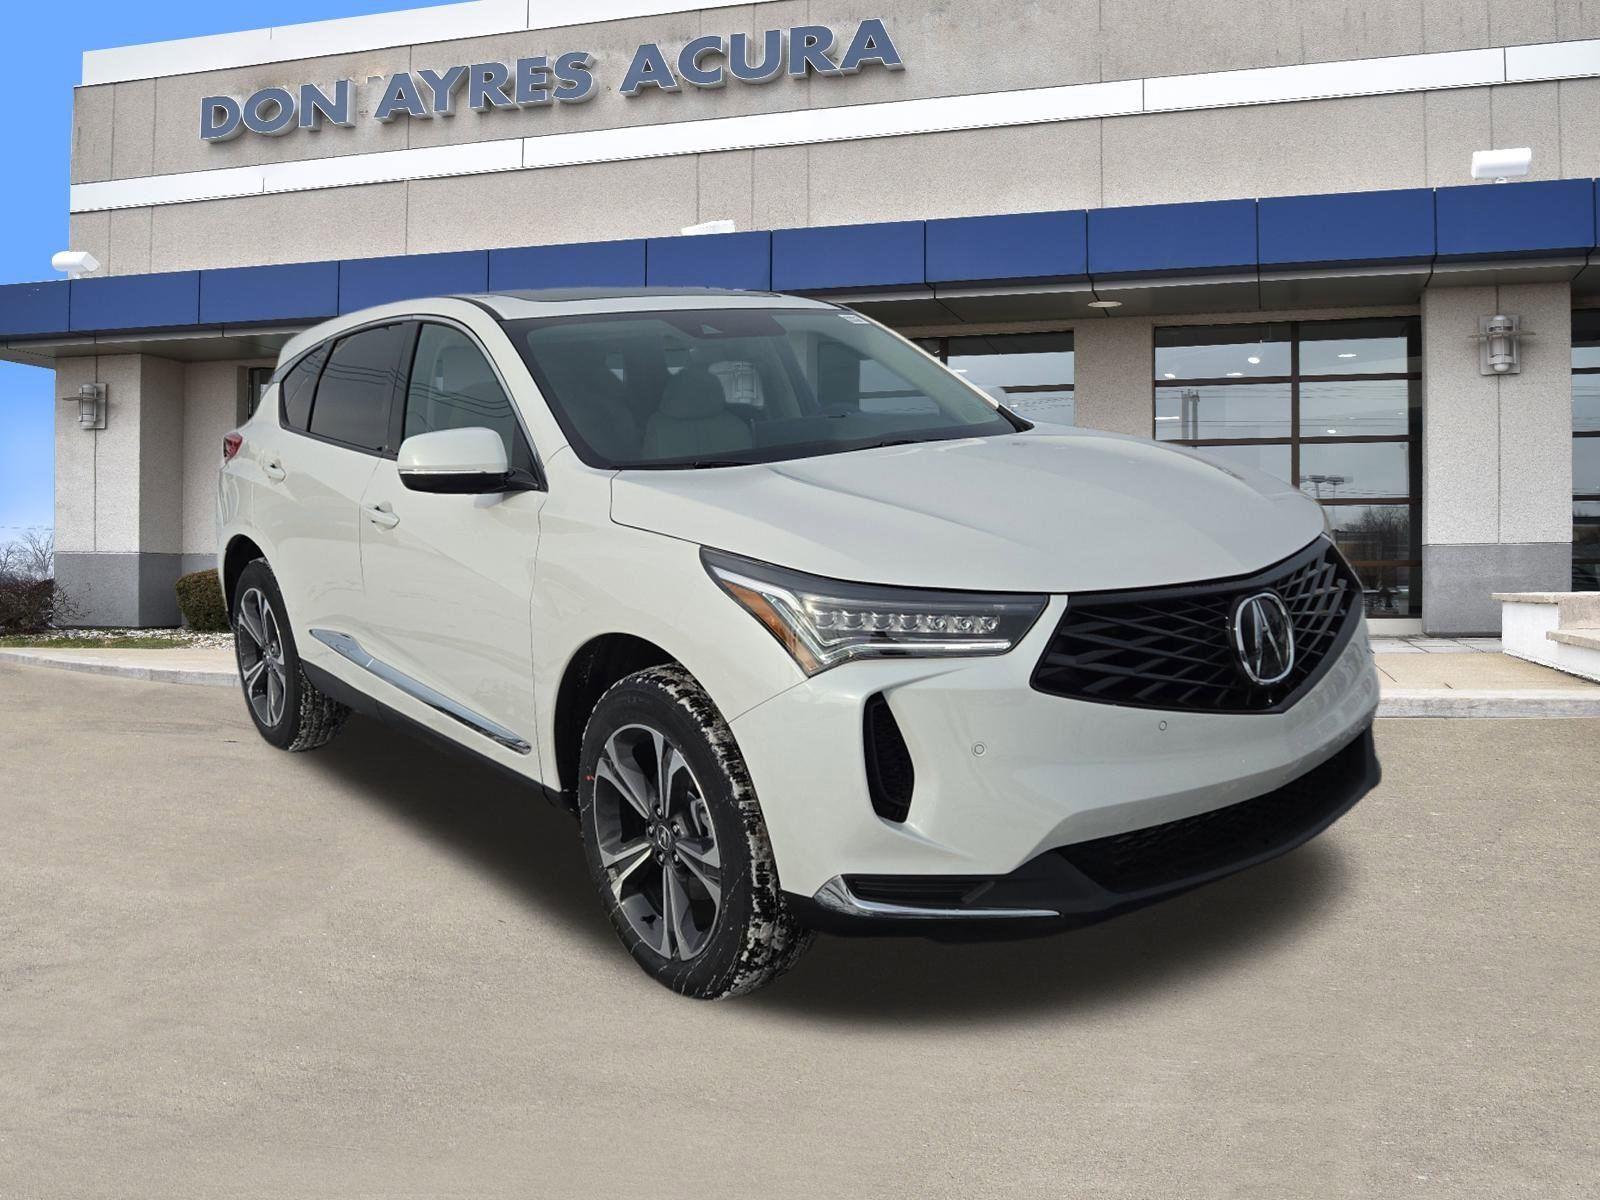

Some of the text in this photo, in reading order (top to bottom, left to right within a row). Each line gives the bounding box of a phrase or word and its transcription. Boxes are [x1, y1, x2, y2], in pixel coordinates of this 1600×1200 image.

[200, 18, 904, 141] DON AYRES ACURA
